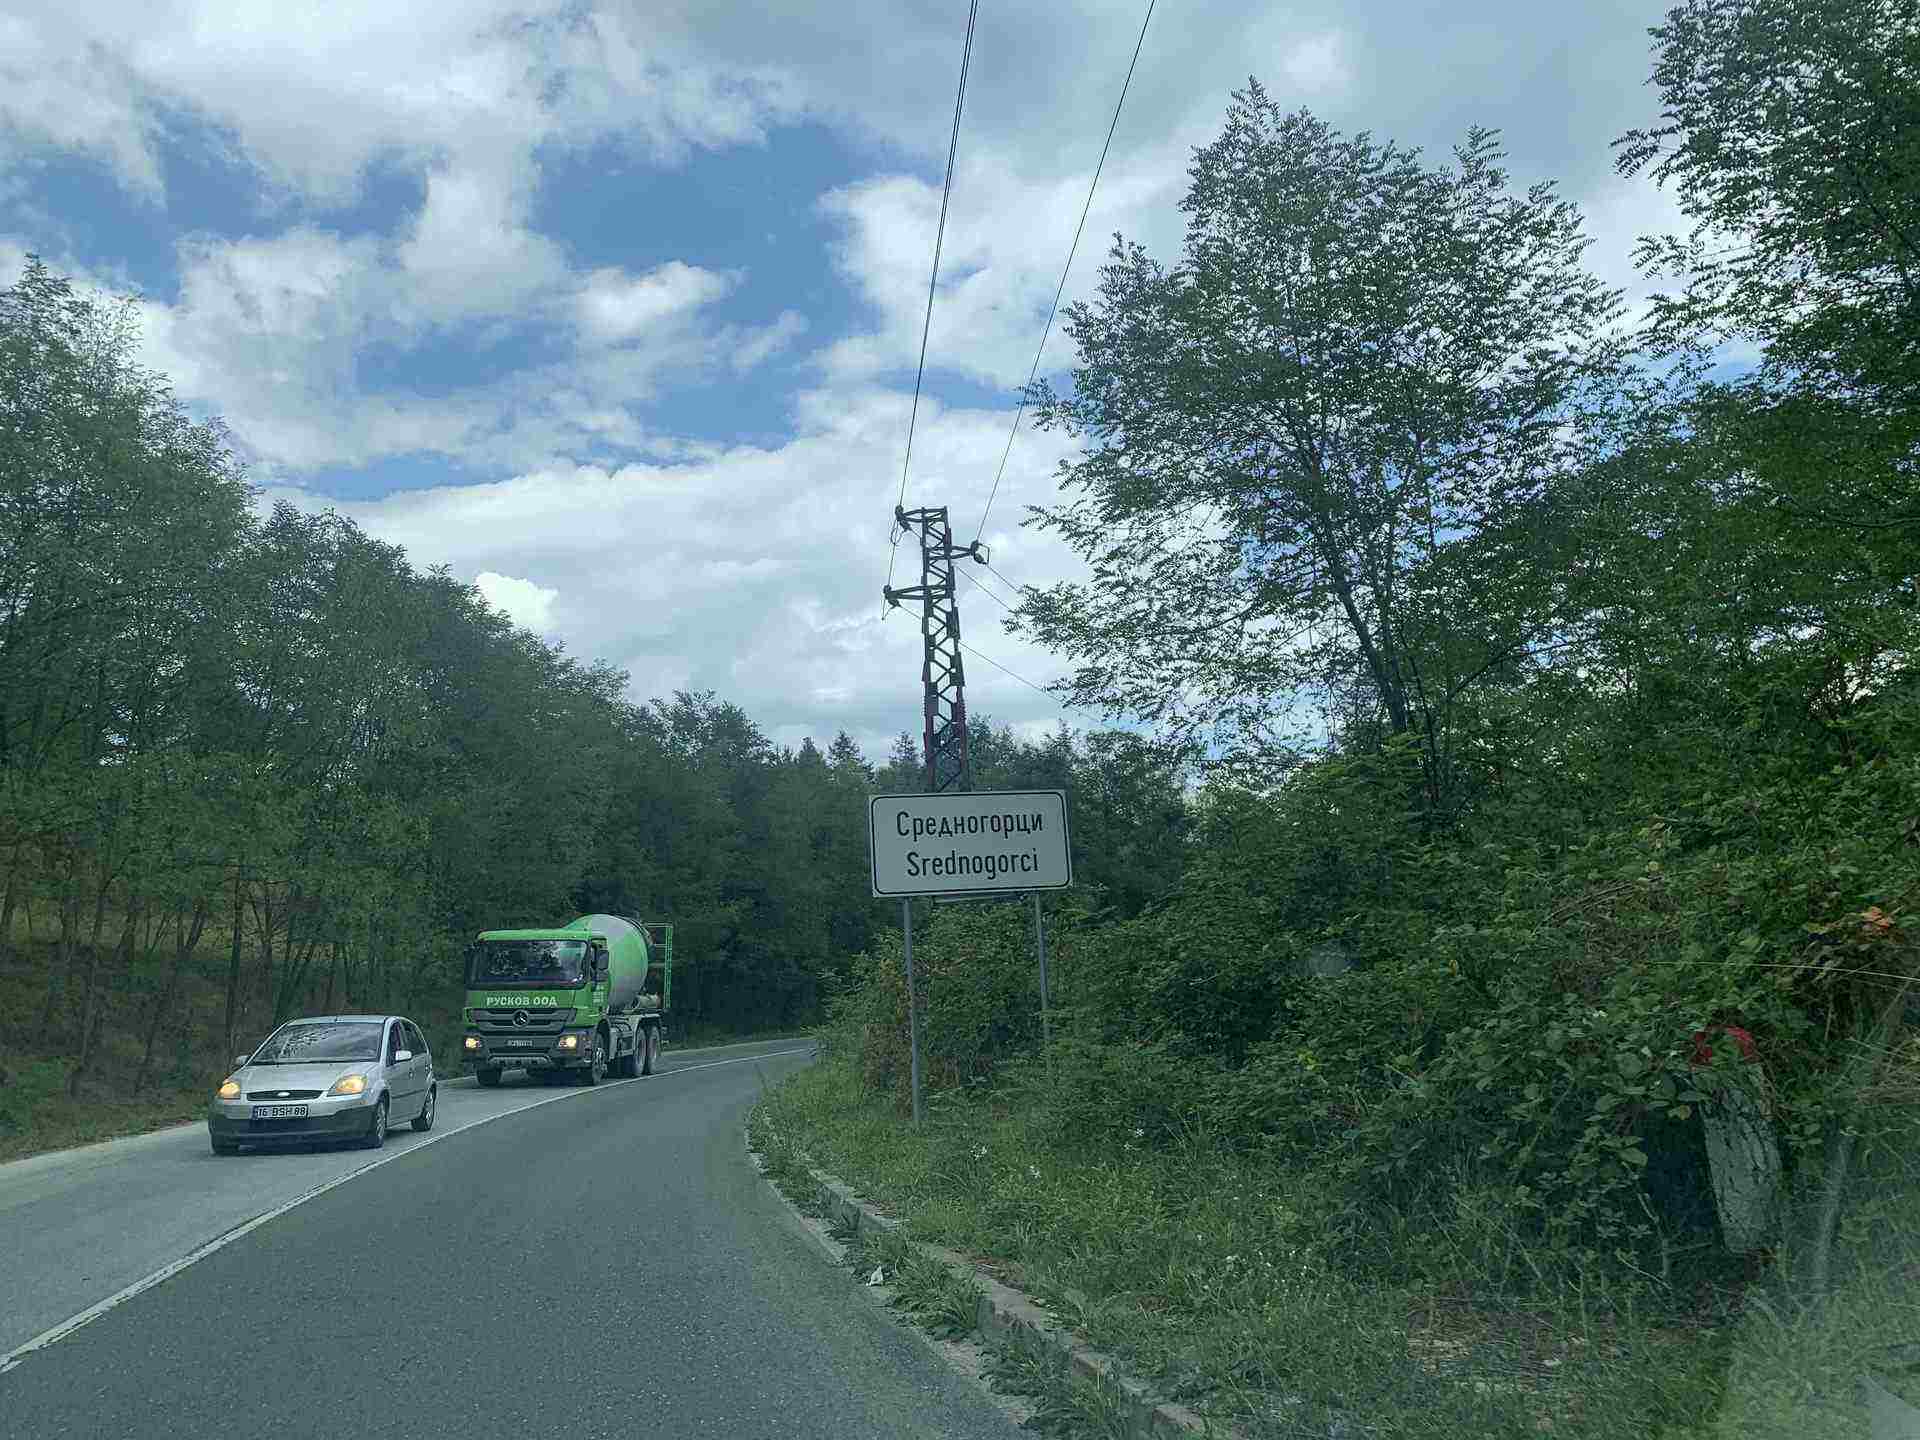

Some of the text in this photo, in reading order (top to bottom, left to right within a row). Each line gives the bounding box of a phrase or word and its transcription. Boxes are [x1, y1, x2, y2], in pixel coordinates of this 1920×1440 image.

[896, 811, 1043, 841] Средногорци
[907, 848, 1039, 880] Srednogorci
[486, 996, 559, 1008] РУСКОВ ООД
